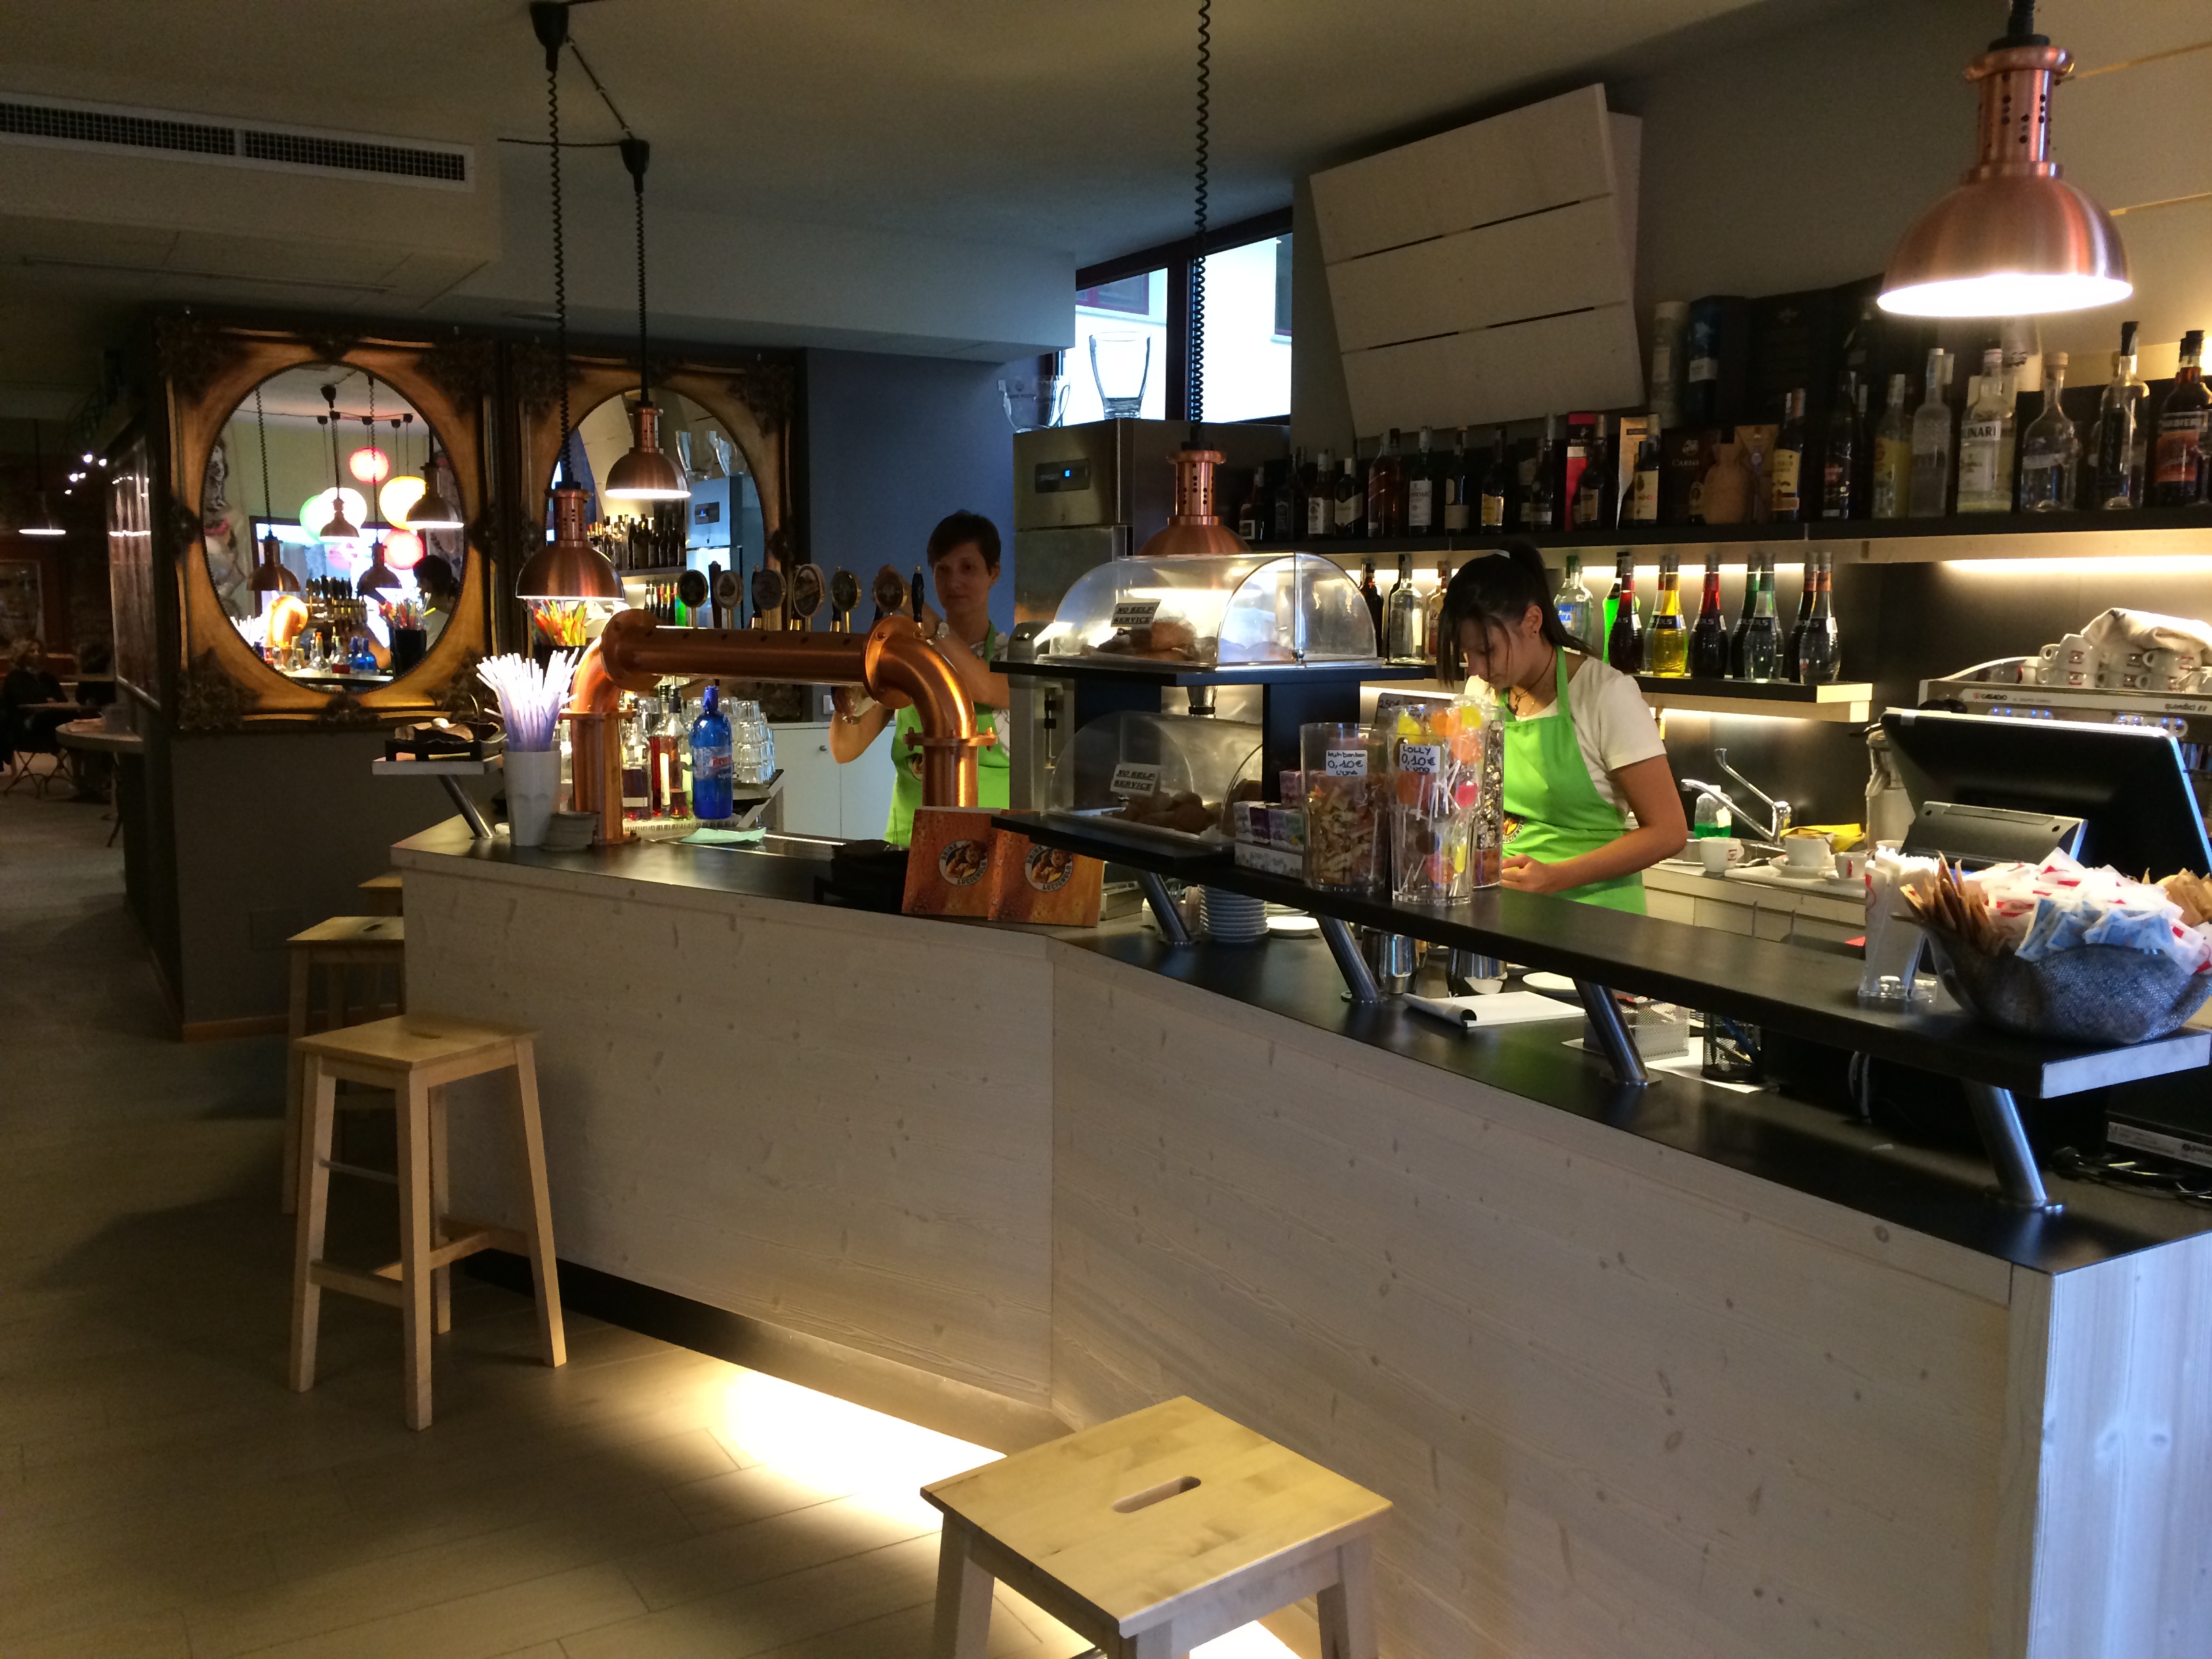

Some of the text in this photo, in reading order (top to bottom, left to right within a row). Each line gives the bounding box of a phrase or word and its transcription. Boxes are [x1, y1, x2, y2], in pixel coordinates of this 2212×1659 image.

[1403, 745, 1431, 755] LOLLY
[1328, 760, 1364, 769] 0,10€
[1401, 753, 1436, 766] 0,10€
[1117, 769, 1130, 777] NO
[1113, 779, 1153, 791] SERVICE
[941, 842, 959, 861] DRINK
[1027, 845, 1044, 864] DRINK
[957, 861, 987, 885] LUCIGNOLO
[1042, 865, 1072, 890] LUCIGNOLO
